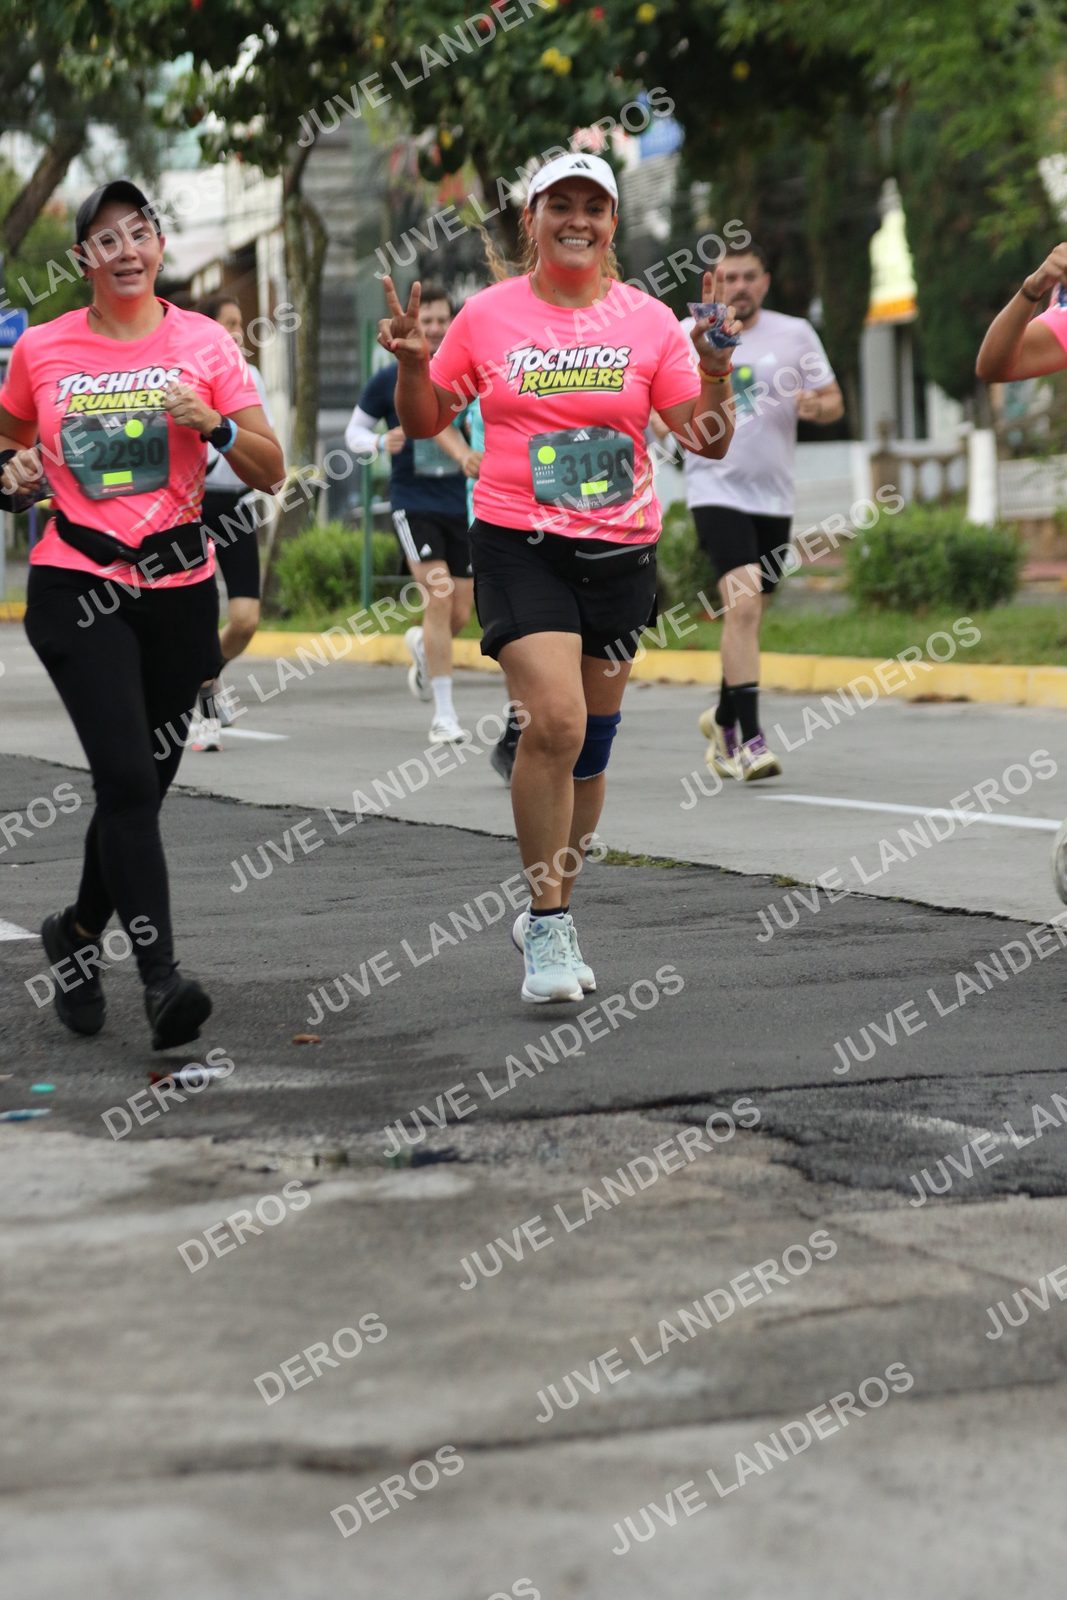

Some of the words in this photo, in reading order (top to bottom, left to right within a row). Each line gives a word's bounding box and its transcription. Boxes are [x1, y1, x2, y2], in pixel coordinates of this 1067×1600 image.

[506, 345, 632, 380] TOCHITOS
[55, 366, 182, 404] TOCHITOS
[519, 367, 625, 395] RUNNERS
[66, 389, 167, 414] RUNNER
[91, 437, 165, 470] 2290
[560, 448, 631, 486] 3190
